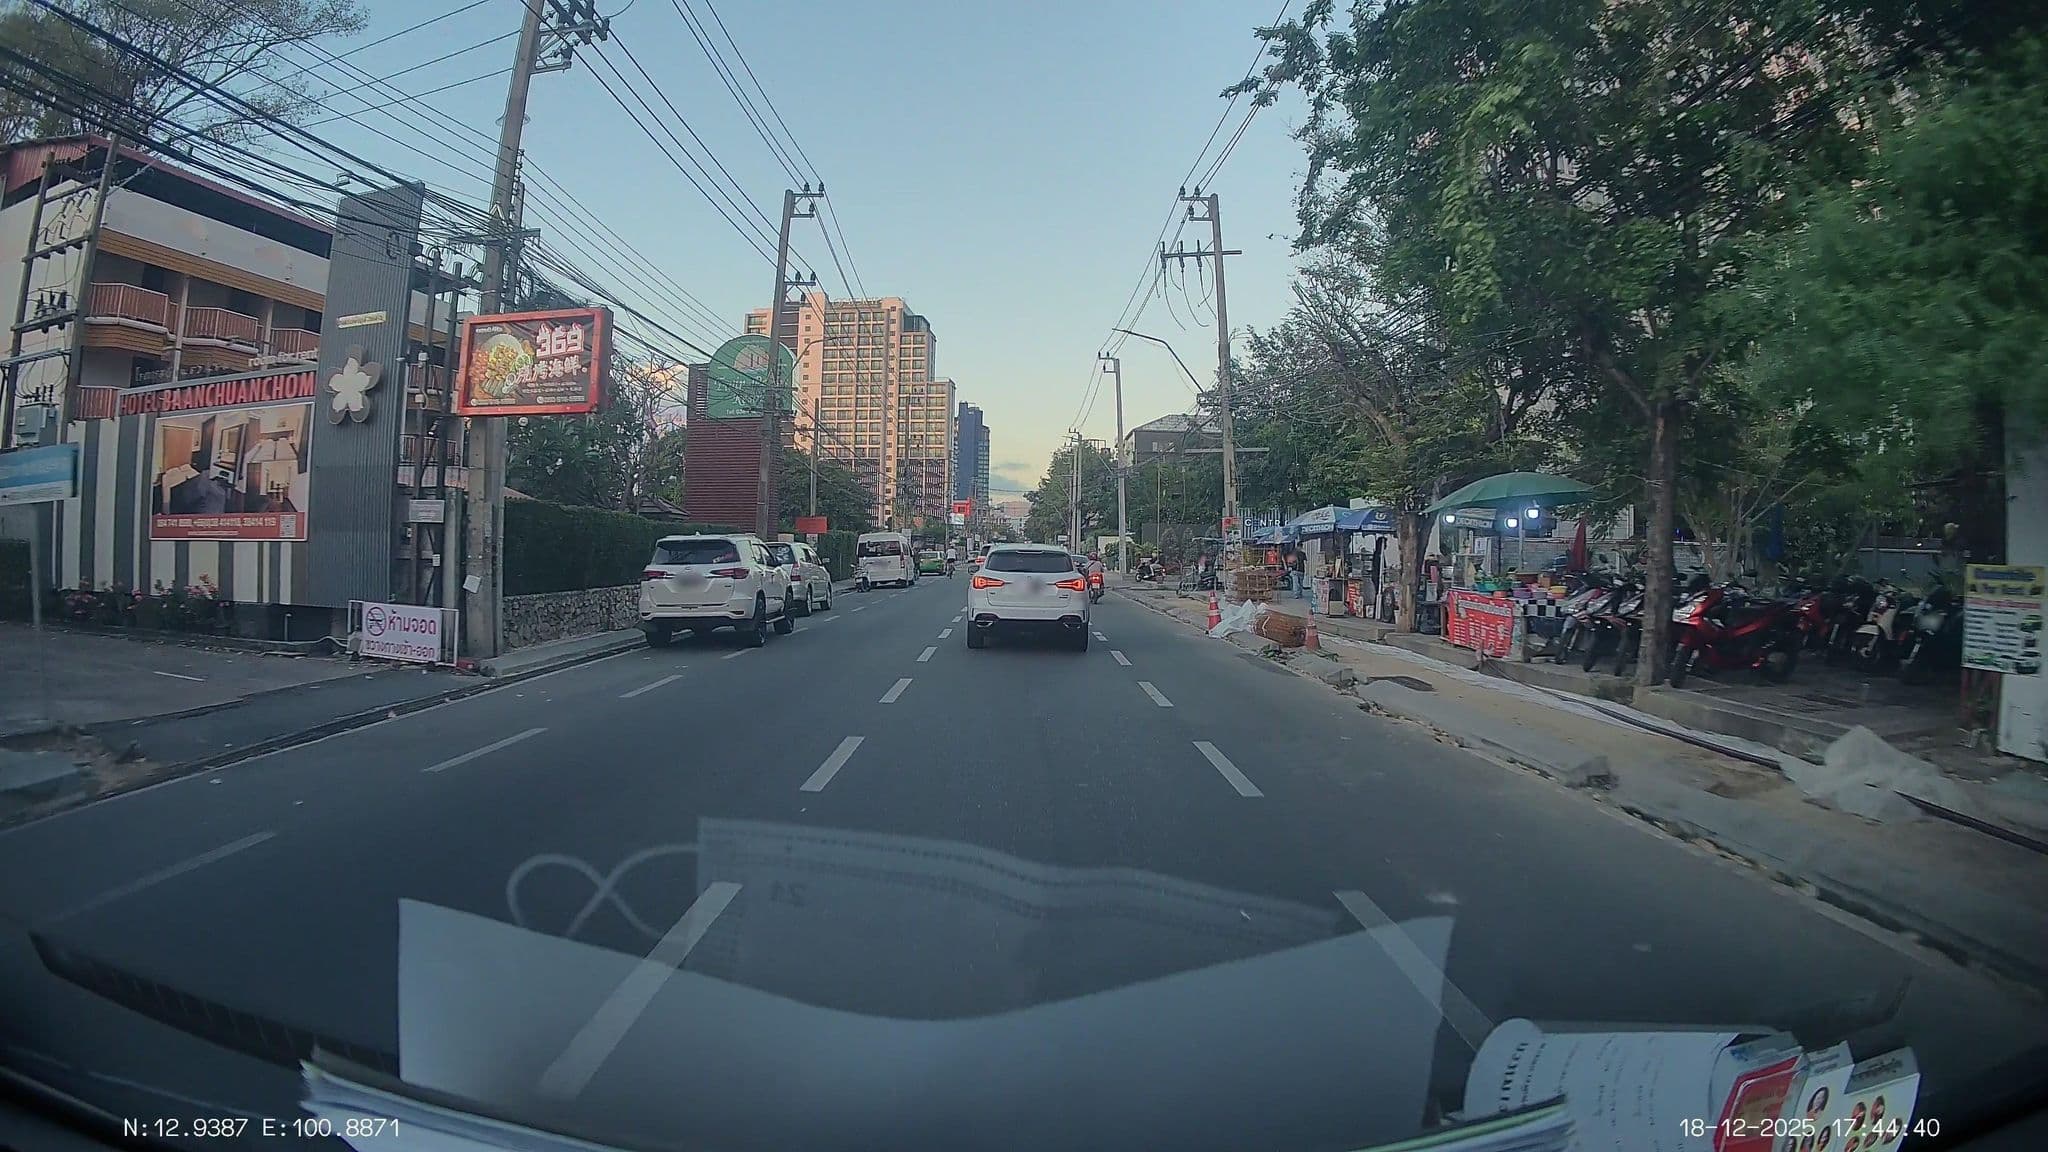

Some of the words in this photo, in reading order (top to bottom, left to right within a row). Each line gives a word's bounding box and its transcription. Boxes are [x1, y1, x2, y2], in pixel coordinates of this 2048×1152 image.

[278, 351, 294, 362] for
[295, 347, 319, 360] rent
[536, 322, 584, 357] 369
[120, 391, 157, 415] HOTEL
[162, 371, 315, 411] BAANCHUANCHOM
[387, 609, 437, 635] ห้ามจอด
